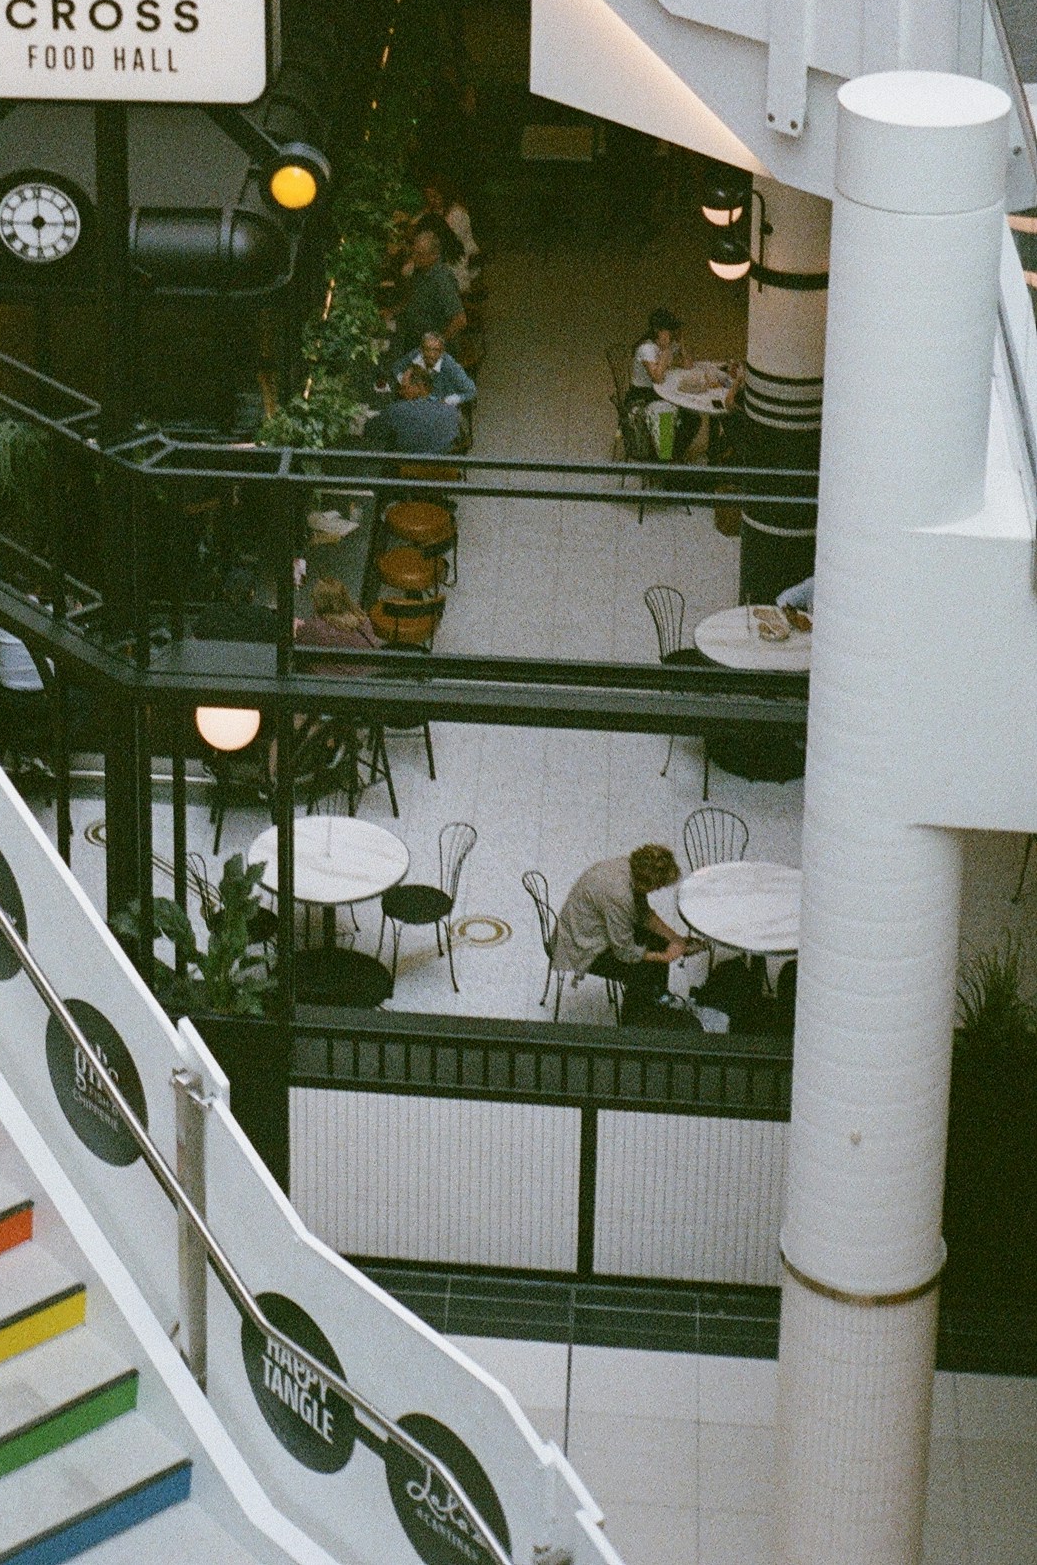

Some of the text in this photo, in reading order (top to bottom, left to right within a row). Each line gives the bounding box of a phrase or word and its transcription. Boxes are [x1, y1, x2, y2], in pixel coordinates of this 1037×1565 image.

[27, 45, 179, 73] FOOD HALL
[262, 1354, 335, 1446] TANGLE
